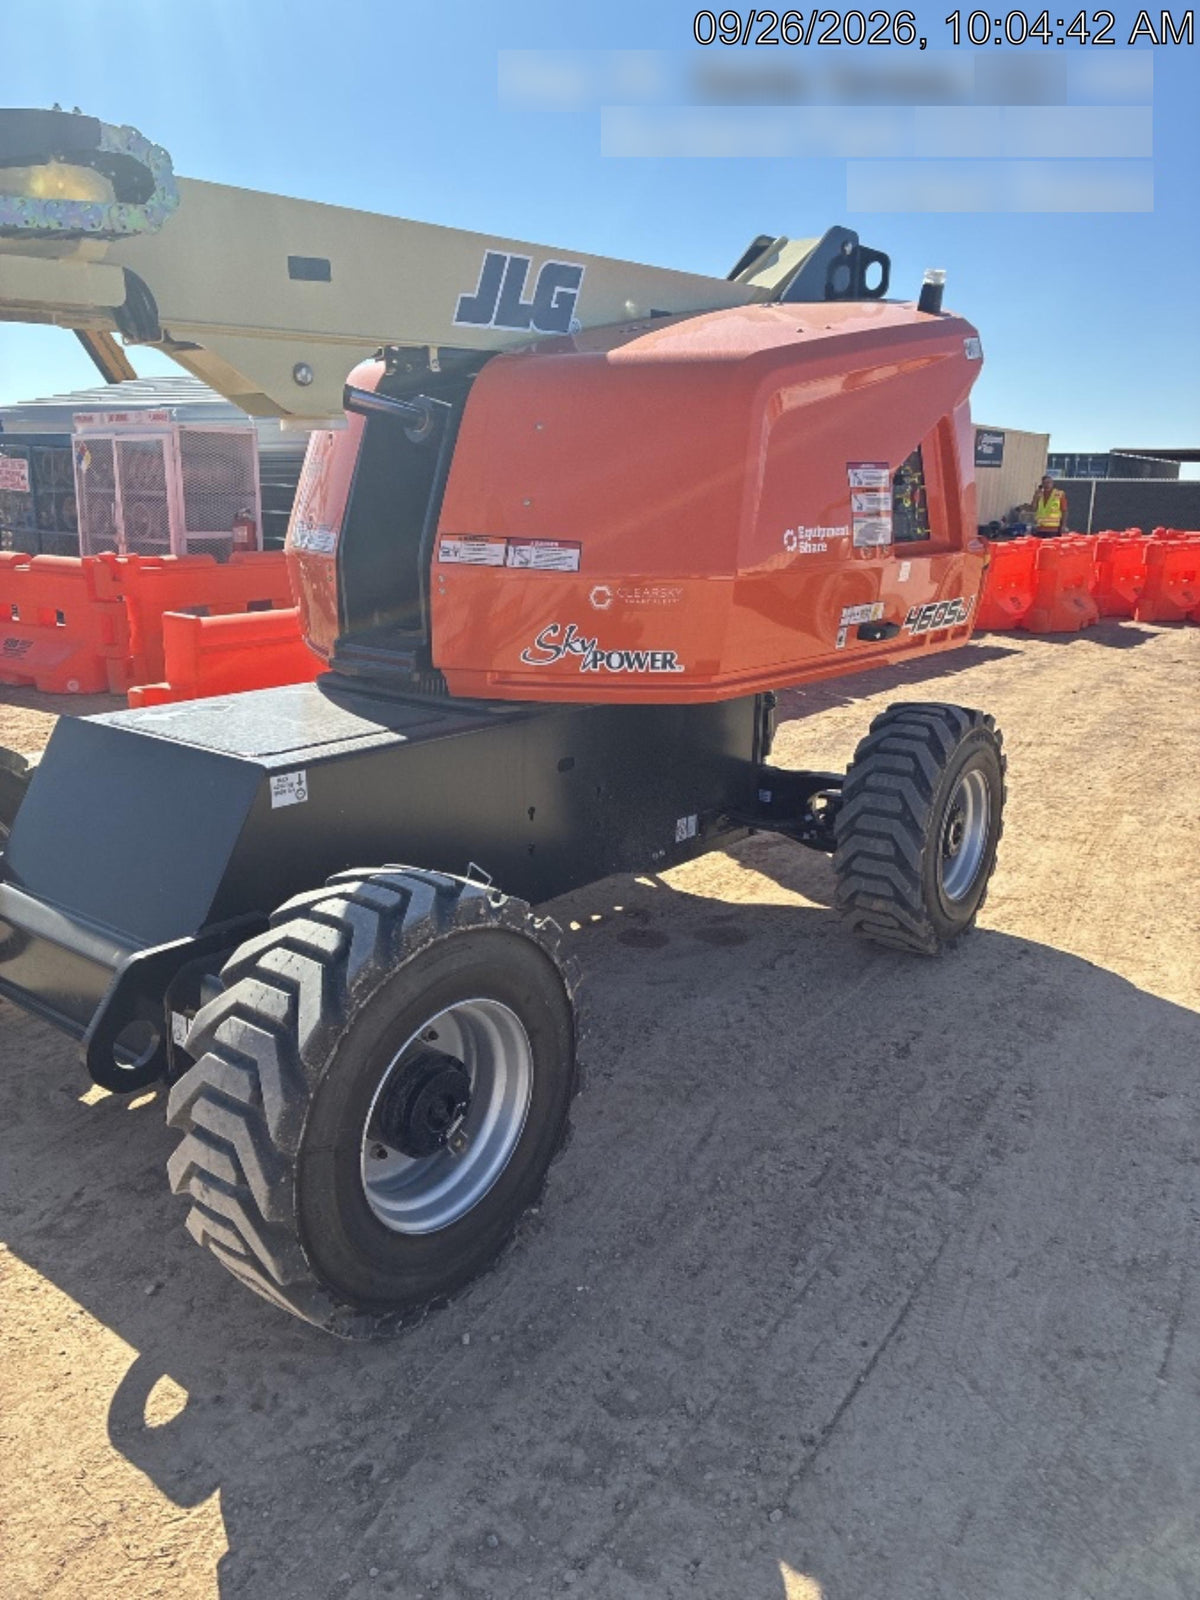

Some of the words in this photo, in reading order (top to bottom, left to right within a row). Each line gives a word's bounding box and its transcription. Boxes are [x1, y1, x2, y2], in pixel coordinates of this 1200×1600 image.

[452, 249, 586, 336] JLG
[521, 624, 598, 672] Sky
[589, 650, 685, 673] POWER
